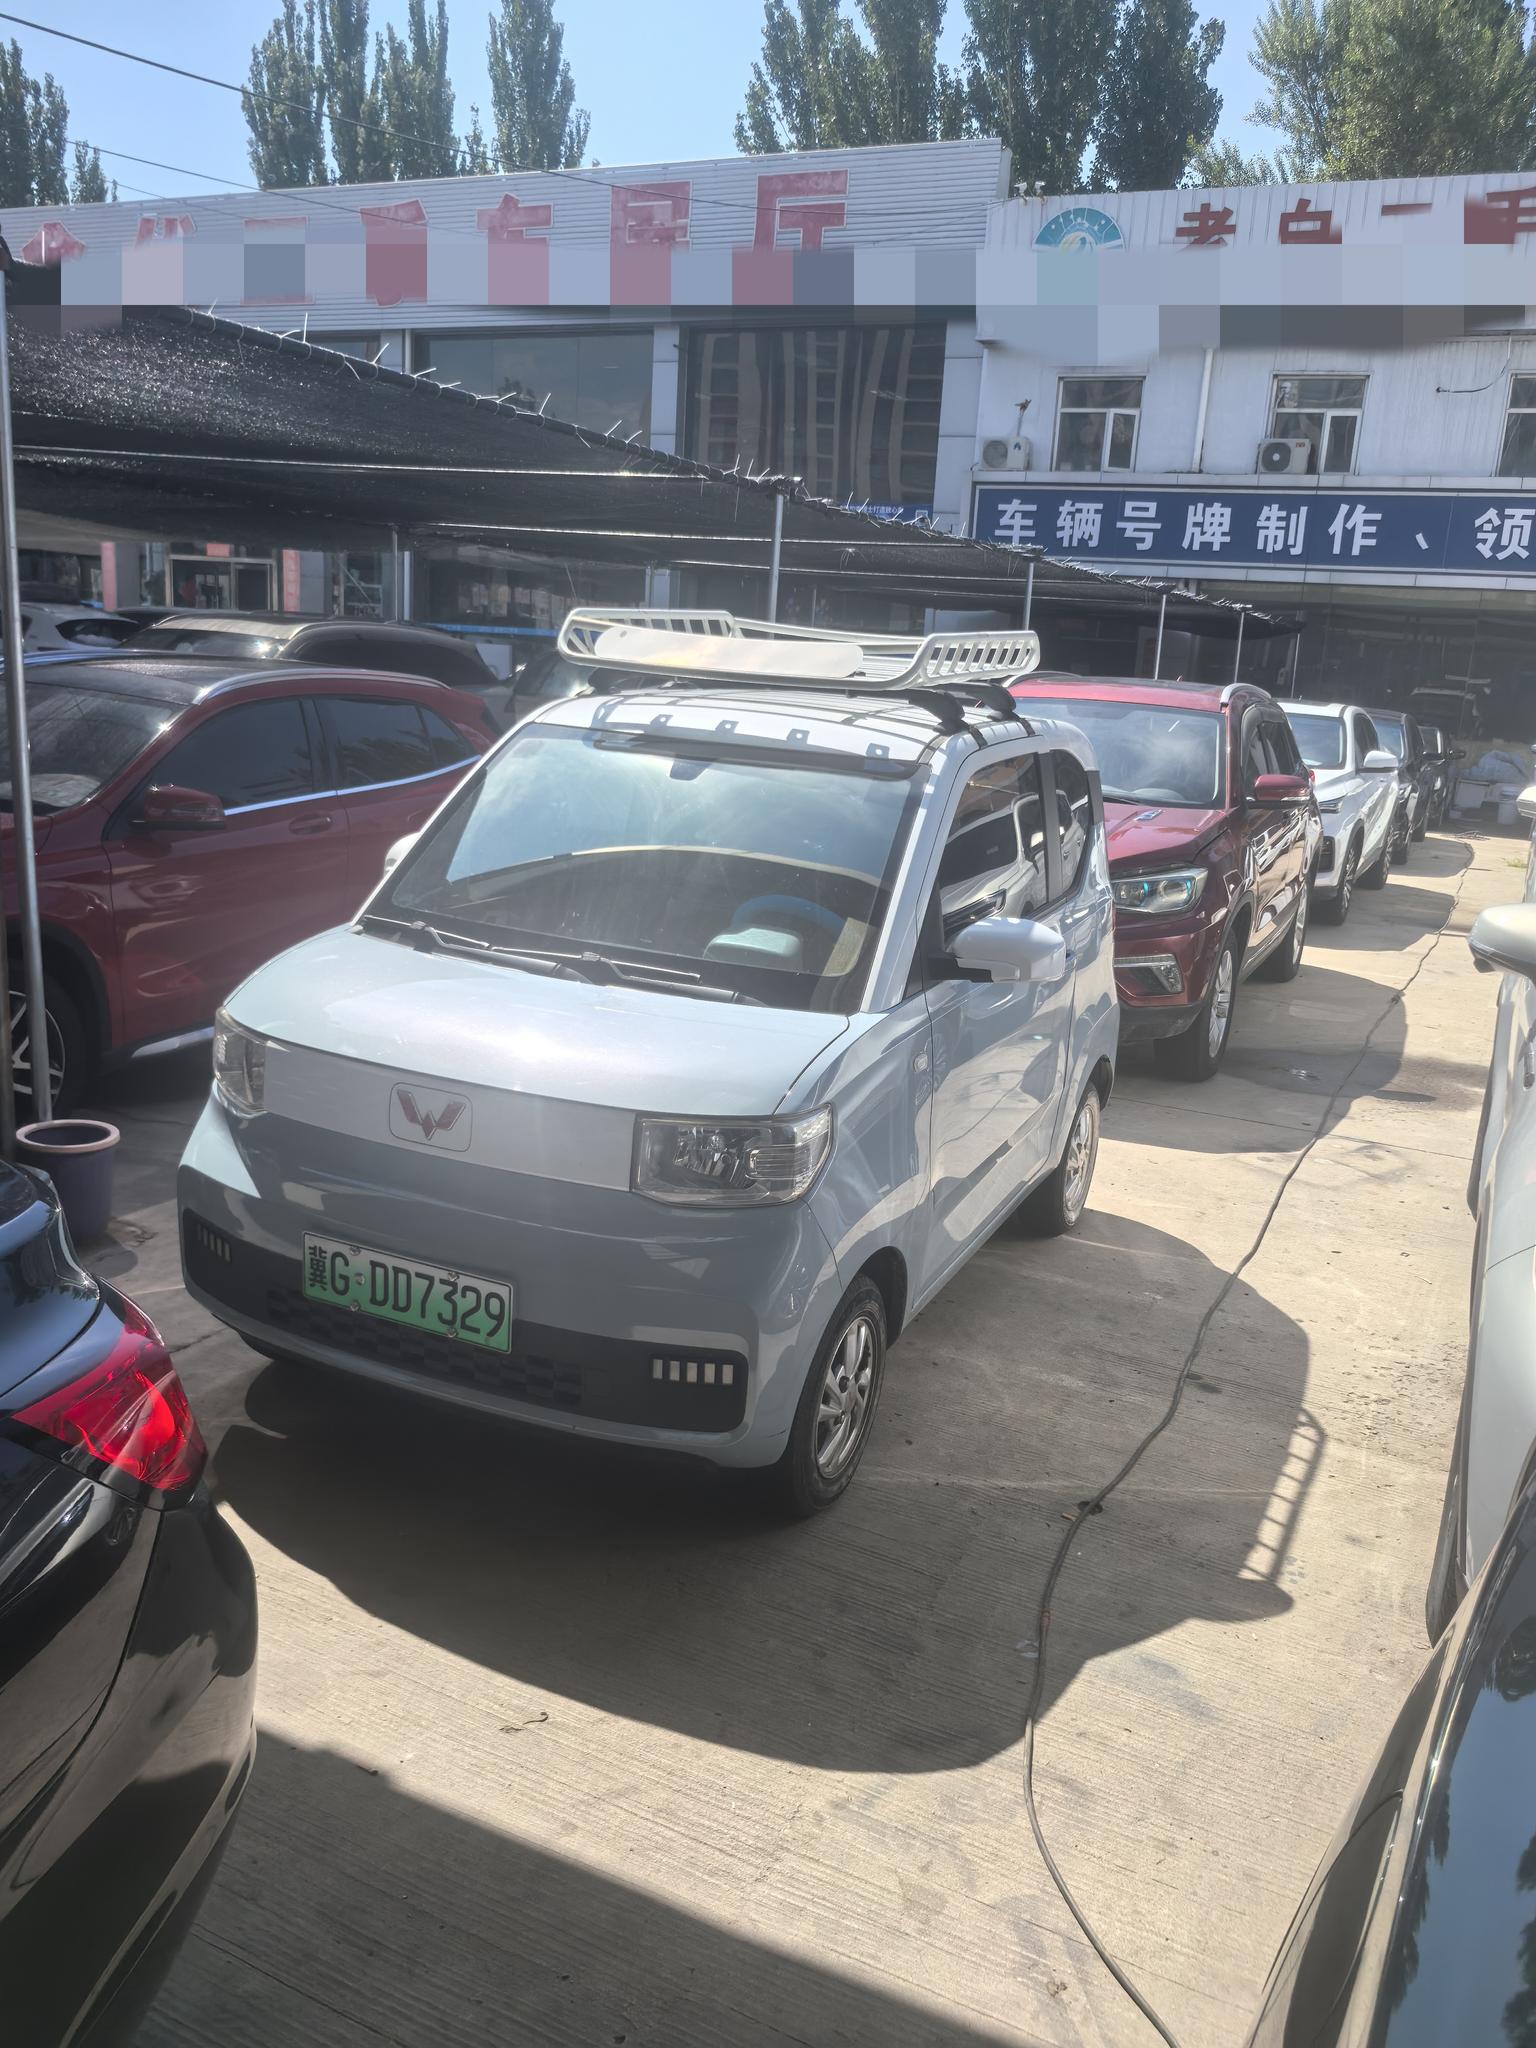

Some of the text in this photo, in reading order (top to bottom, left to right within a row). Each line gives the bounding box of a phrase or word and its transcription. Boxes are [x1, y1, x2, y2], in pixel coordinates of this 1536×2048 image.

[995, 499, 1536, 561] 车辆号牌制作、领
